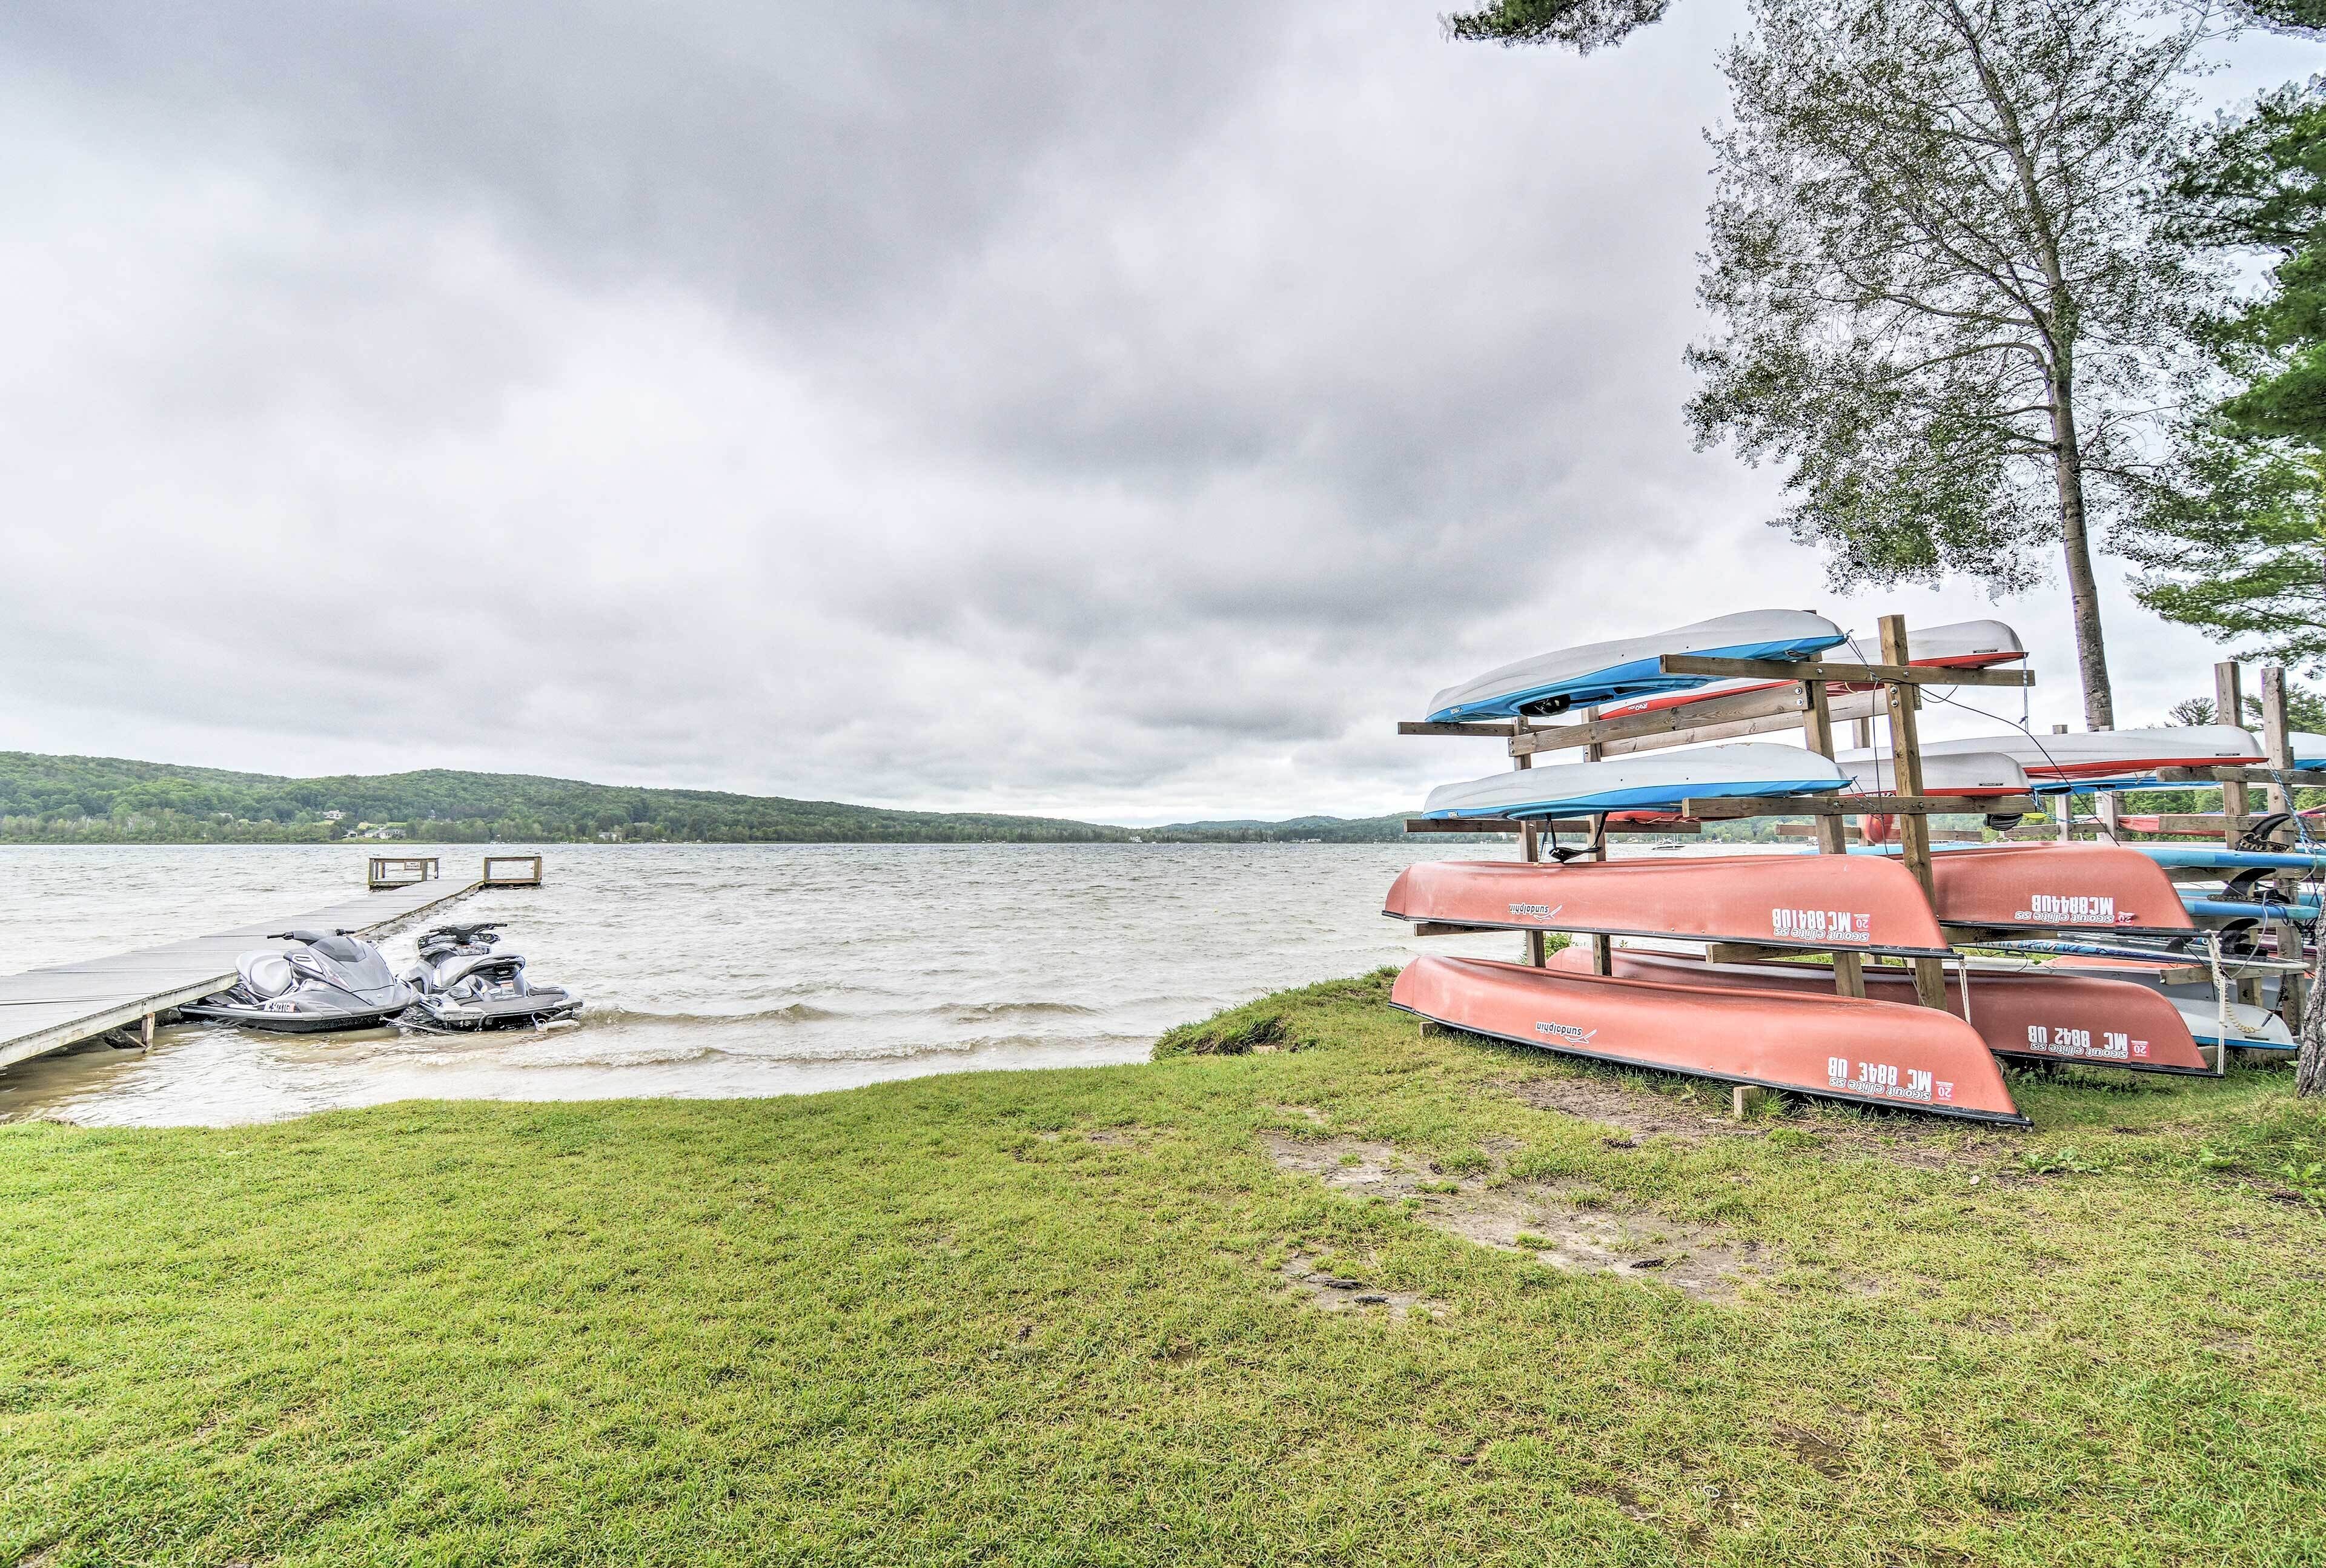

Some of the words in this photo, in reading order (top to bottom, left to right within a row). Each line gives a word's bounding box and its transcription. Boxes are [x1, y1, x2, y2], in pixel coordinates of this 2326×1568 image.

[1508, 902, 1549, 915] sundolphin
[2013, 911, 2032, 921] ss
[2032, 911, 2069, 924] elite
[2070, 913, 2115, 924] scout
[1855, 918, 1869, 928] 20
[1774, 927, 1790, 937] ss
[1791, 928, 1826, 941] elite
[1826, 930, 1870, 942] scout
[1536, 1021, 1582, 1036] sundolphin
[2027, 1025, 2048, 1044] UB
[2054, 1027, 2090, 1048] 8842
[2103, 1032, 2128, 1051] MC
[2029, 1042, 2047, 1051] ss
[2048, 1043, 2084, 1057] elite
[2085, 1047, 2128, 1059] scout
[2133, 1044, 2147, 1054] 20
[1827, 1056, 1848, 1079] UB
[1828, 1077, 1847, 1088] ss
[1907, 1068, 1932, 1092] MC
[1847, 1079, 1885, 1095] elite
[1886, 1085, 1932, 1102] scout
[1938, 1087, 1952, 1097] 20
